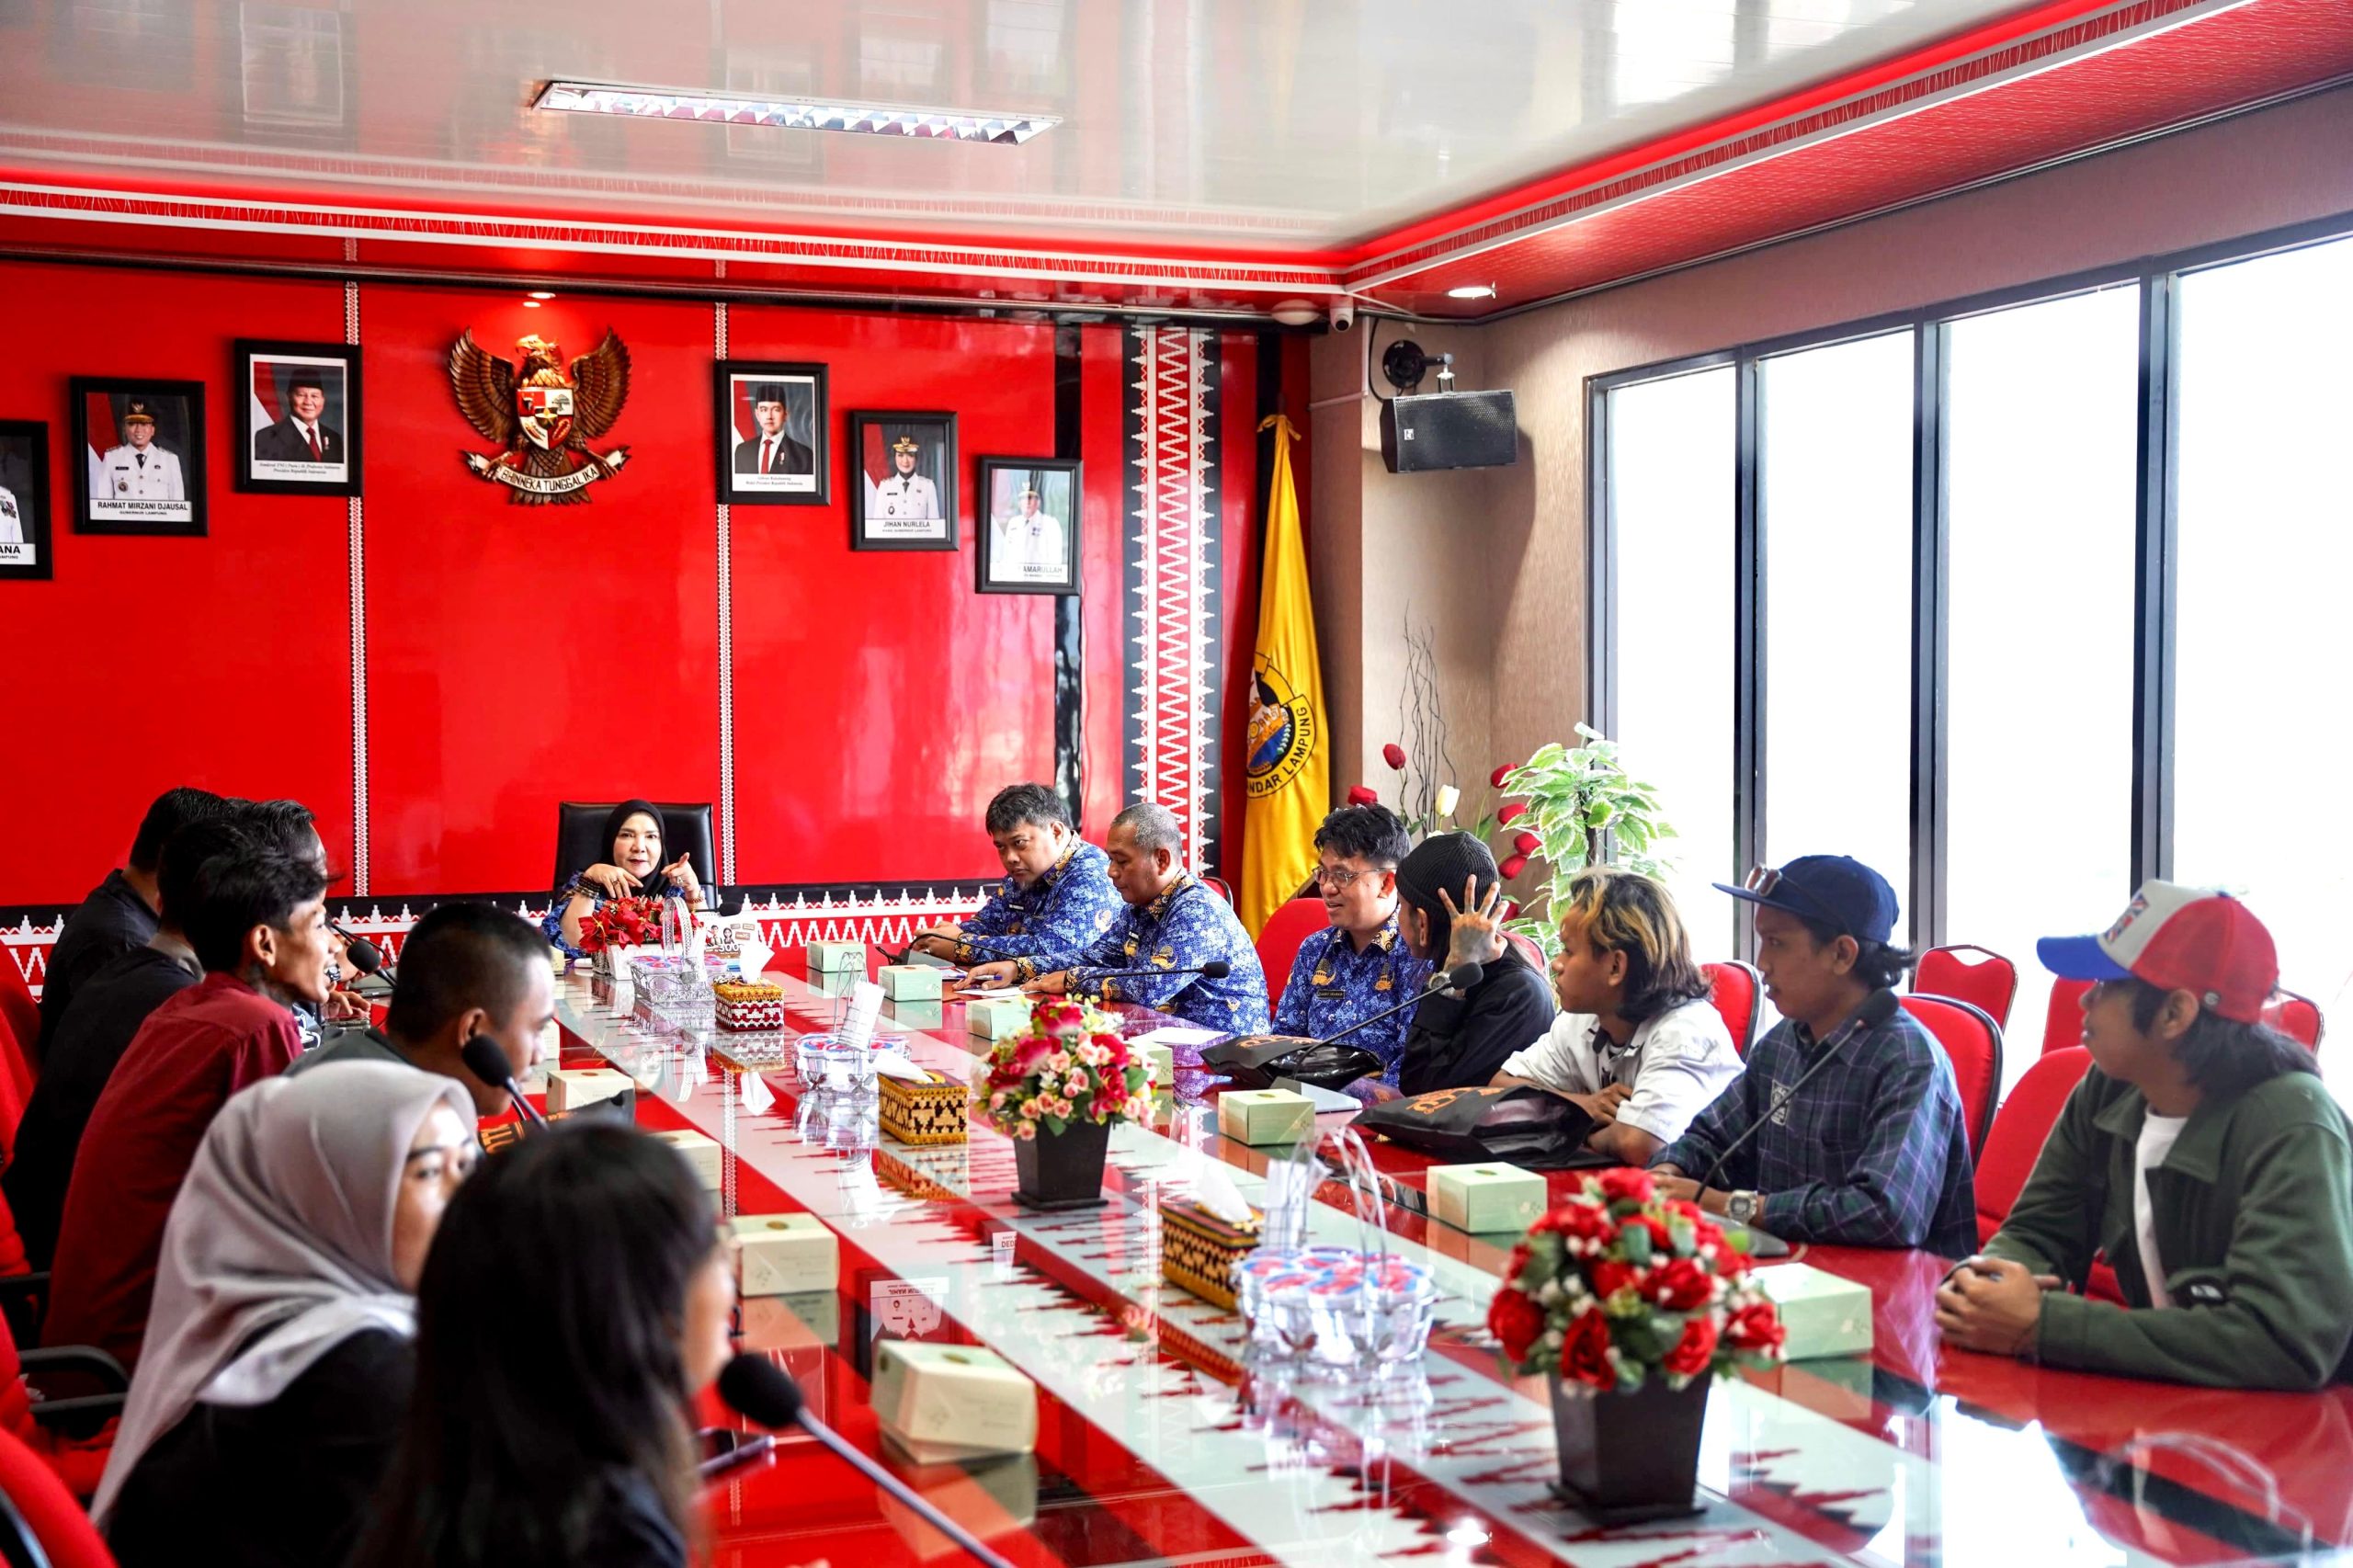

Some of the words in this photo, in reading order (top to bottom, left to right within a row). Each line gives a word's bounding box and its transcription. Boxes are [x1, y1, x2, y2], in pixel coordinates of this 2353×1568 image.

[501, 469, 542, 491] BHINNEKA
[544, 477, 585, 492] TUNGGAL
[582, 467, 598, 482] IKA
[97, 501, 127, 510] RAHMAT
[128, 501, 156, 510] MIRZANI
[157, 502, 188, 511] DJAUSAL
[1282, 706, 1311, 776] LAMPUNG
